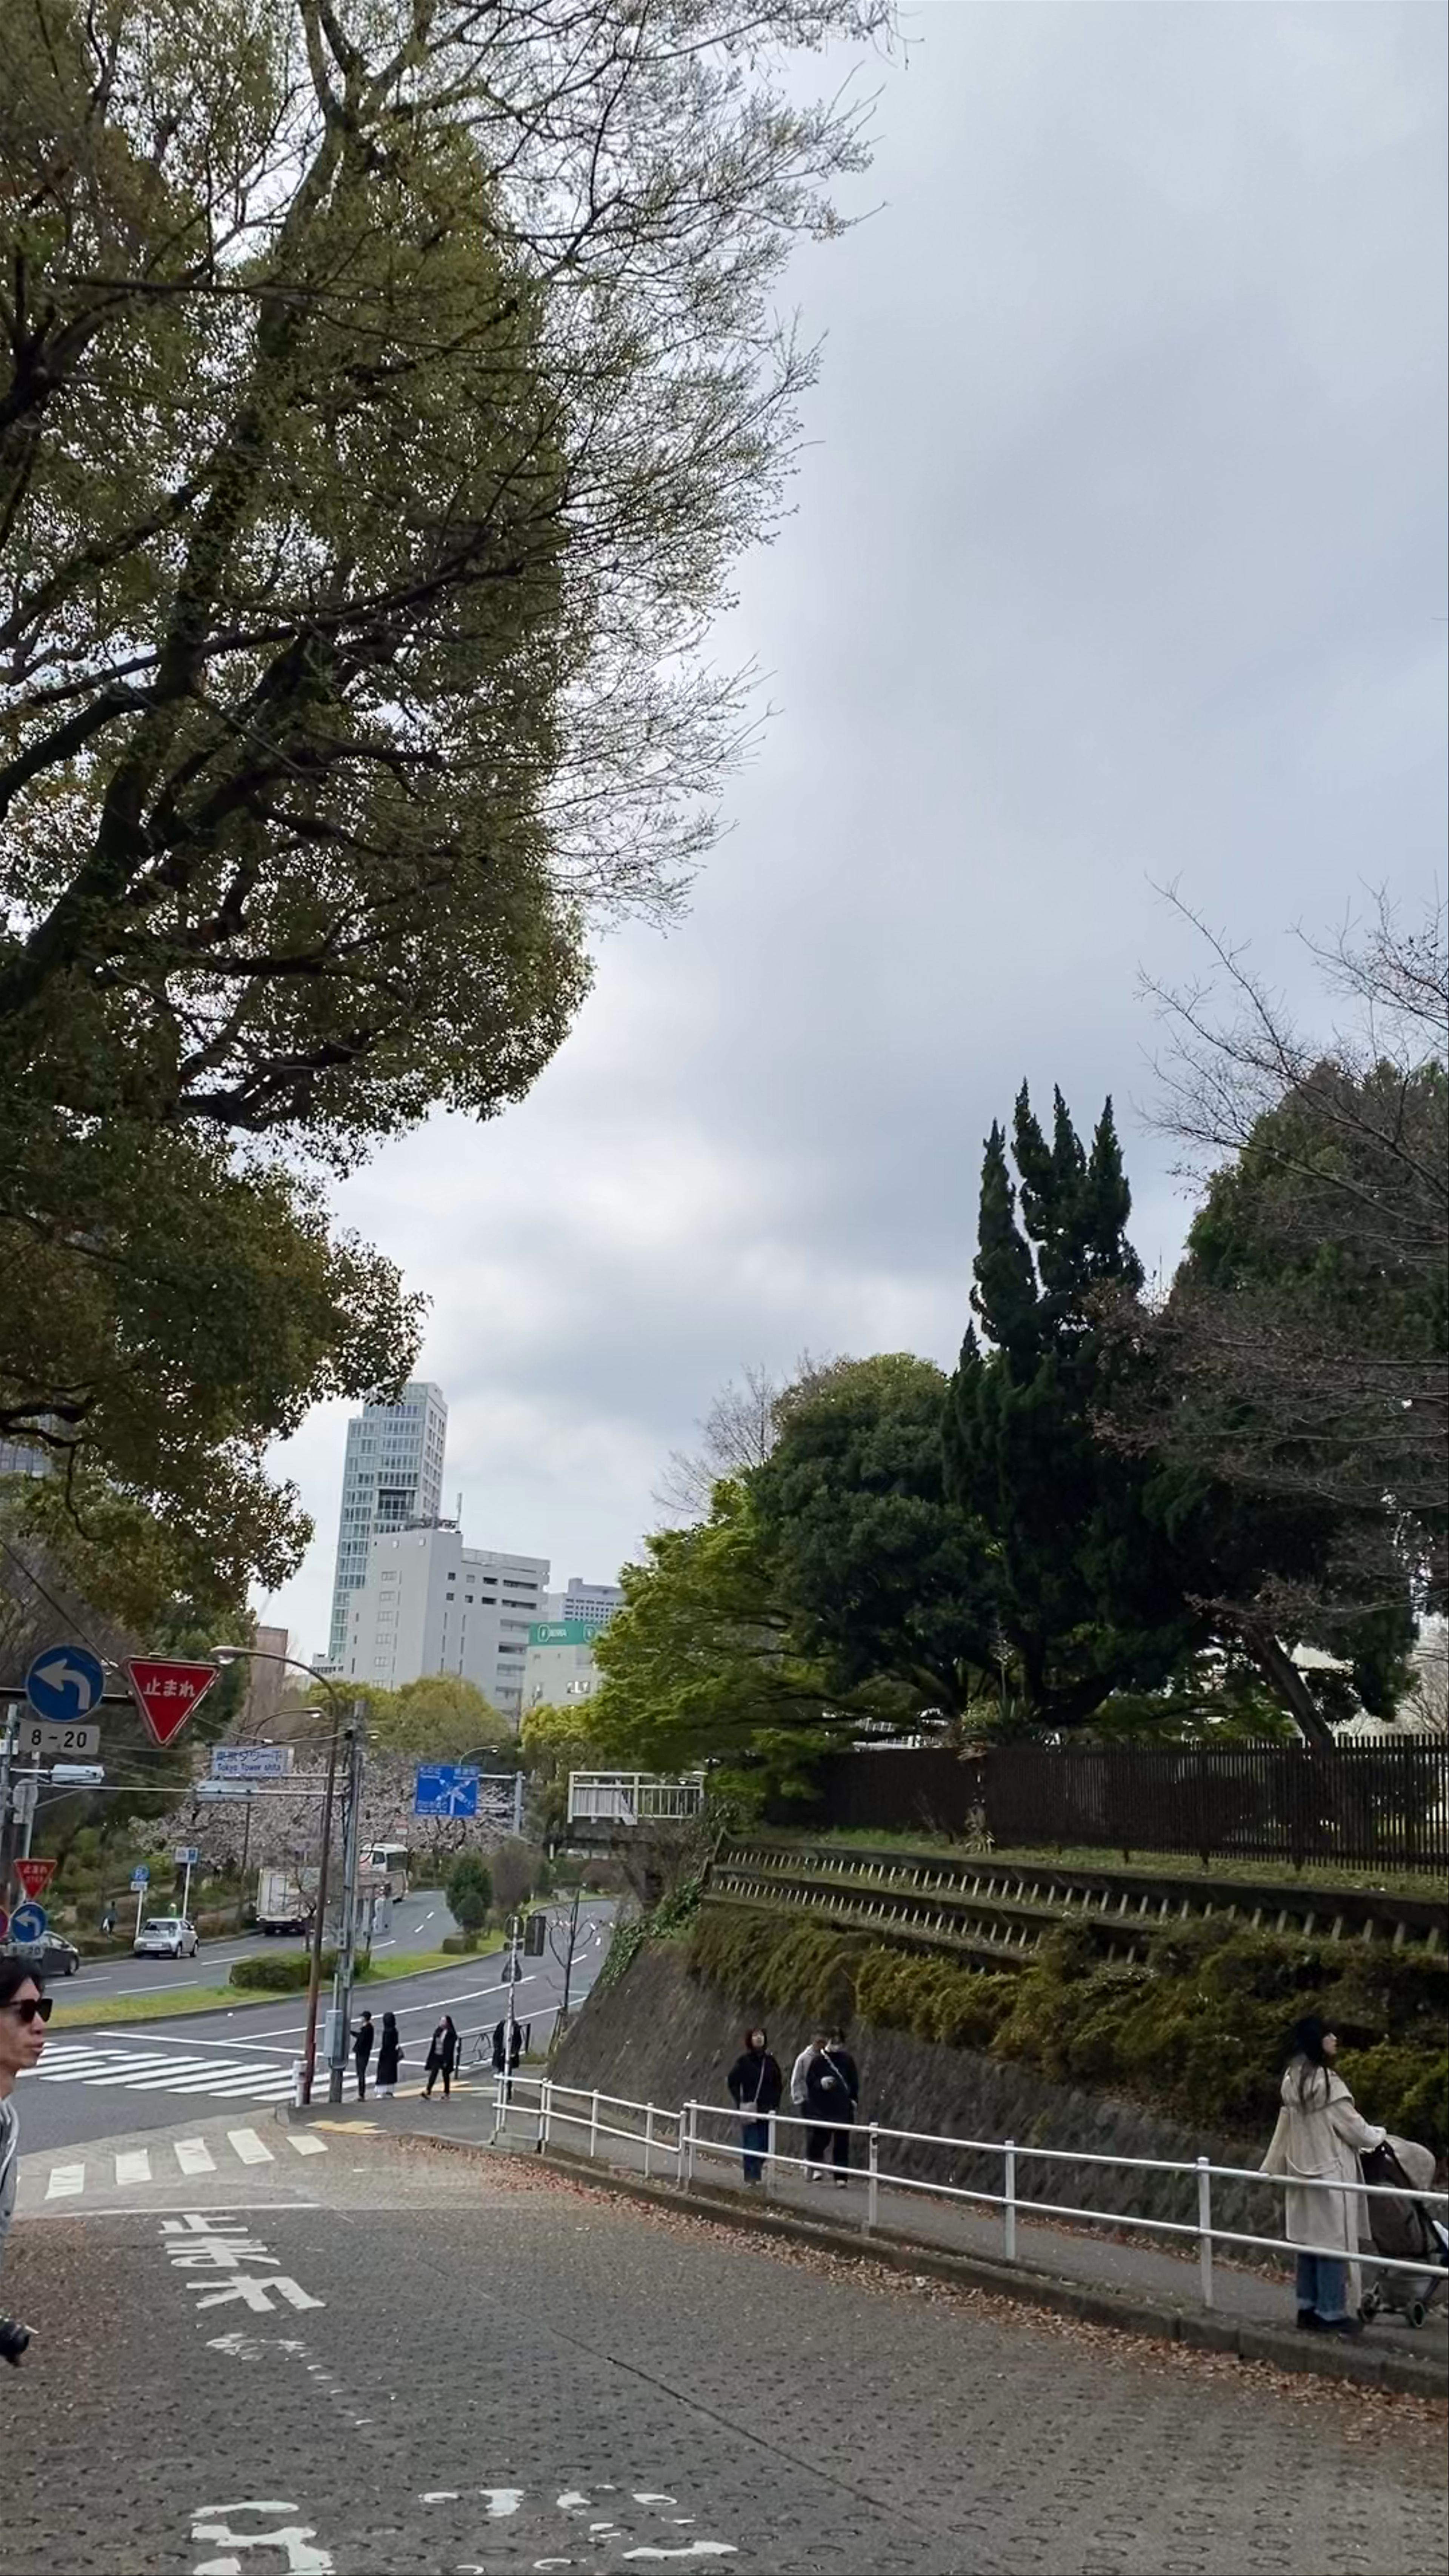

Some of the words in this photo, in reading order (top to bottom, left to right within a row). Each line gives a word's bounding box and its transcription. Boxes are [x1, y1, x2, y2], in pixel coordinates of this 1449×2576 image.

[143, 1676, 195, 1697] 止まれ
[217, 1764, 238, 1773] Tokyo
[158, 2214, 327, 2312] 止まれ
